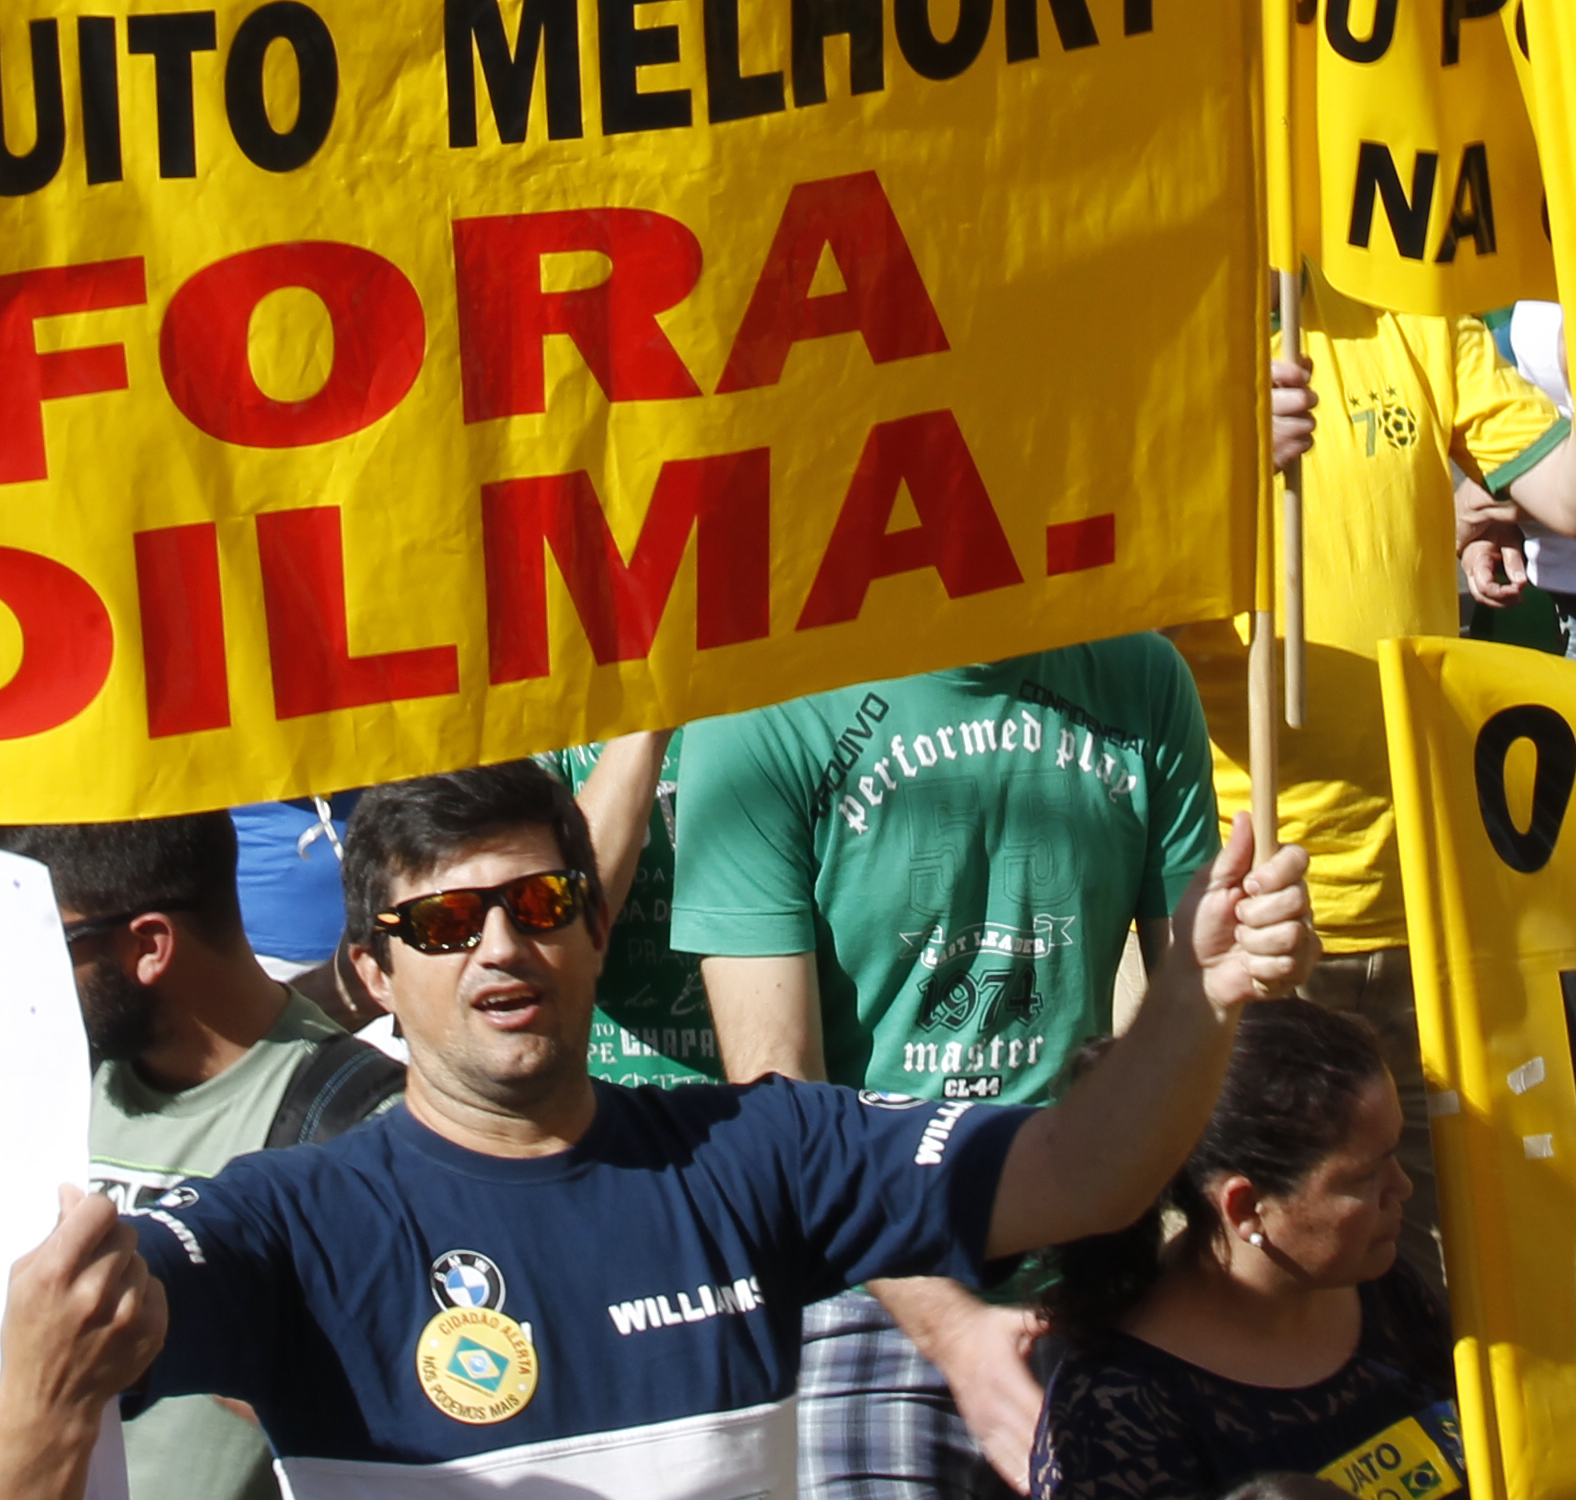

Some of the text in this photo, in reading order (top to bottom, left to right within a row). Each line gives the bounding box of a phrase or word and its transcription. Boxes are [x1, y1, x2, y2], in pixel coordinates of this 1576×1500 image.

[838, 709, 1138, 836] performed play
[974, 930, 1046, 954] LEADER
[916, 964, 1044, 1033] 1974
[903, 1034, 1044, 1074] master
[608, 1275, 766, 1336] WILLIAMS
[489, 1393, 521, 1419] MAIS
